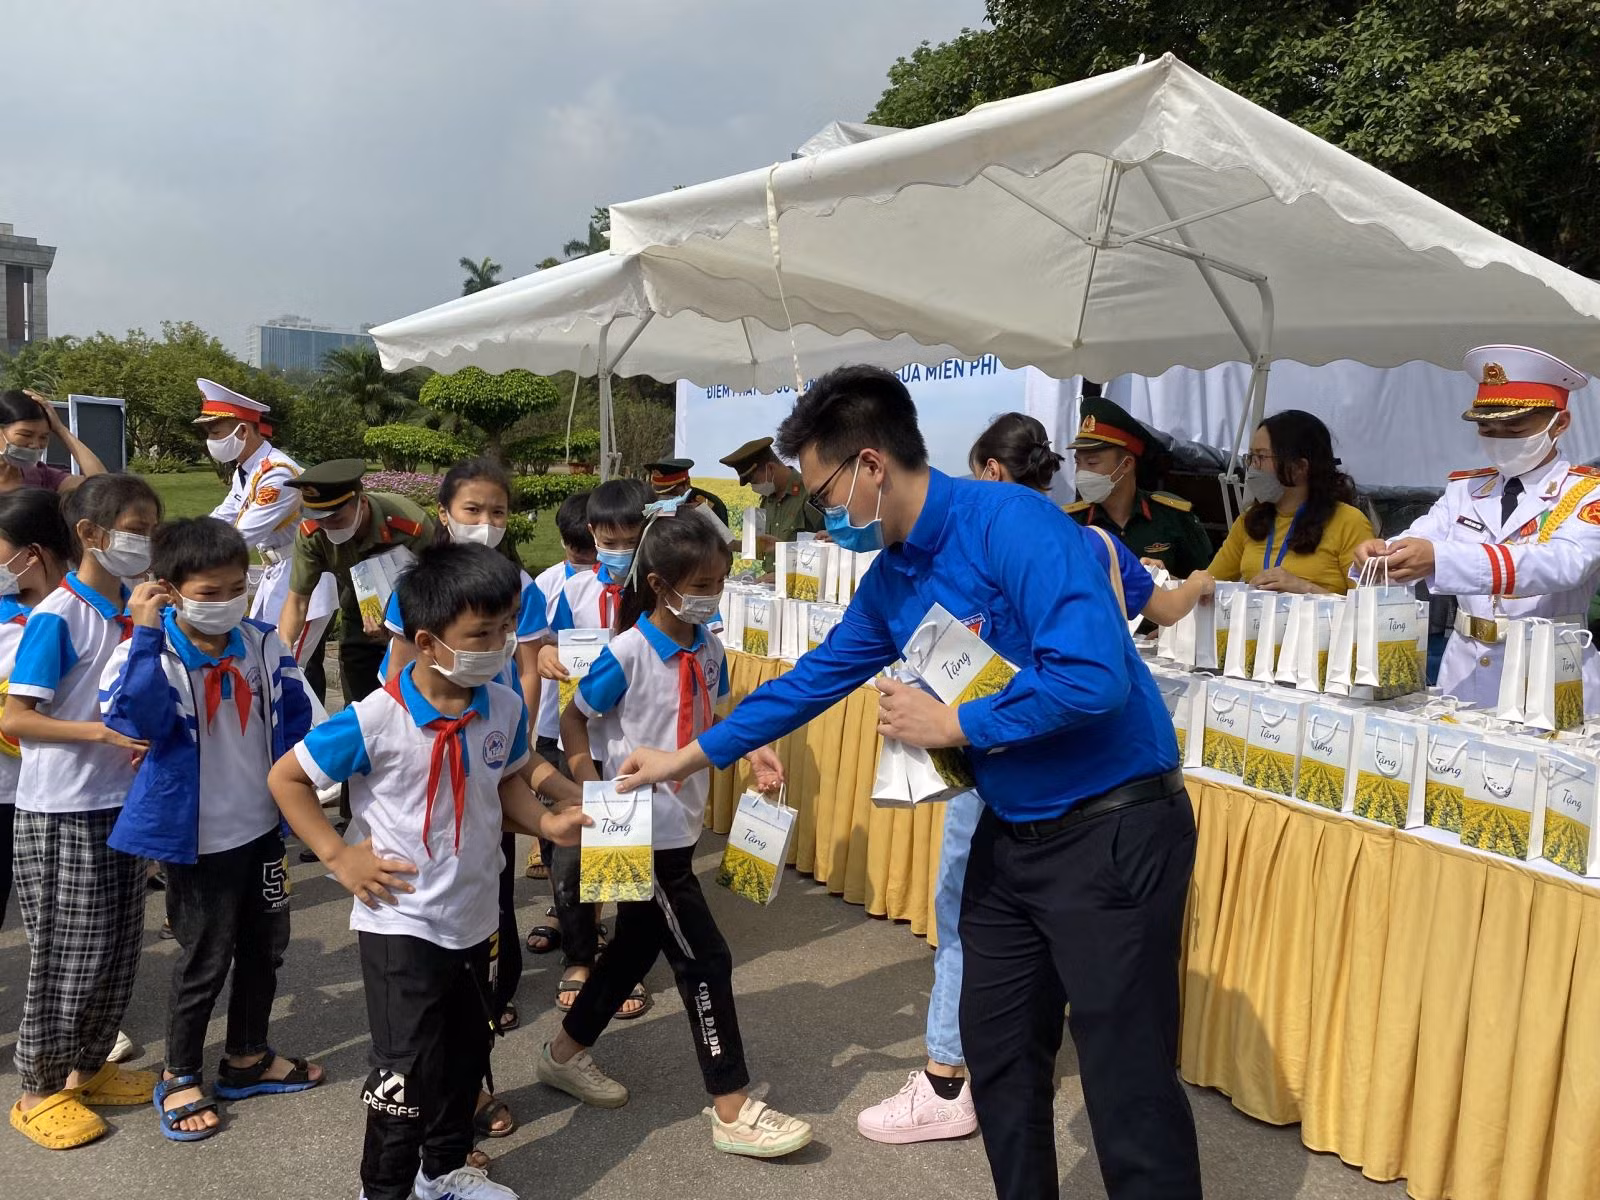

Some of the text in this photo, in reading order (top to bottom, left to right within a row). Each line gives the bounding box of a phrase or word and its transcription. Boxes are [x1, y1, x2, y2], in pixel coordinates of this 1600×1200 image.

[941, 651, 973, 681] Tặng
[1260, 725, 1281, 744] Tặng
[1376, 750, 1397, 770] Tặng
[1562, 788, 1582, 812] Tặng
[601, 817, 632, 837] Tặng
[744, 828, 767, 851] Tặng
